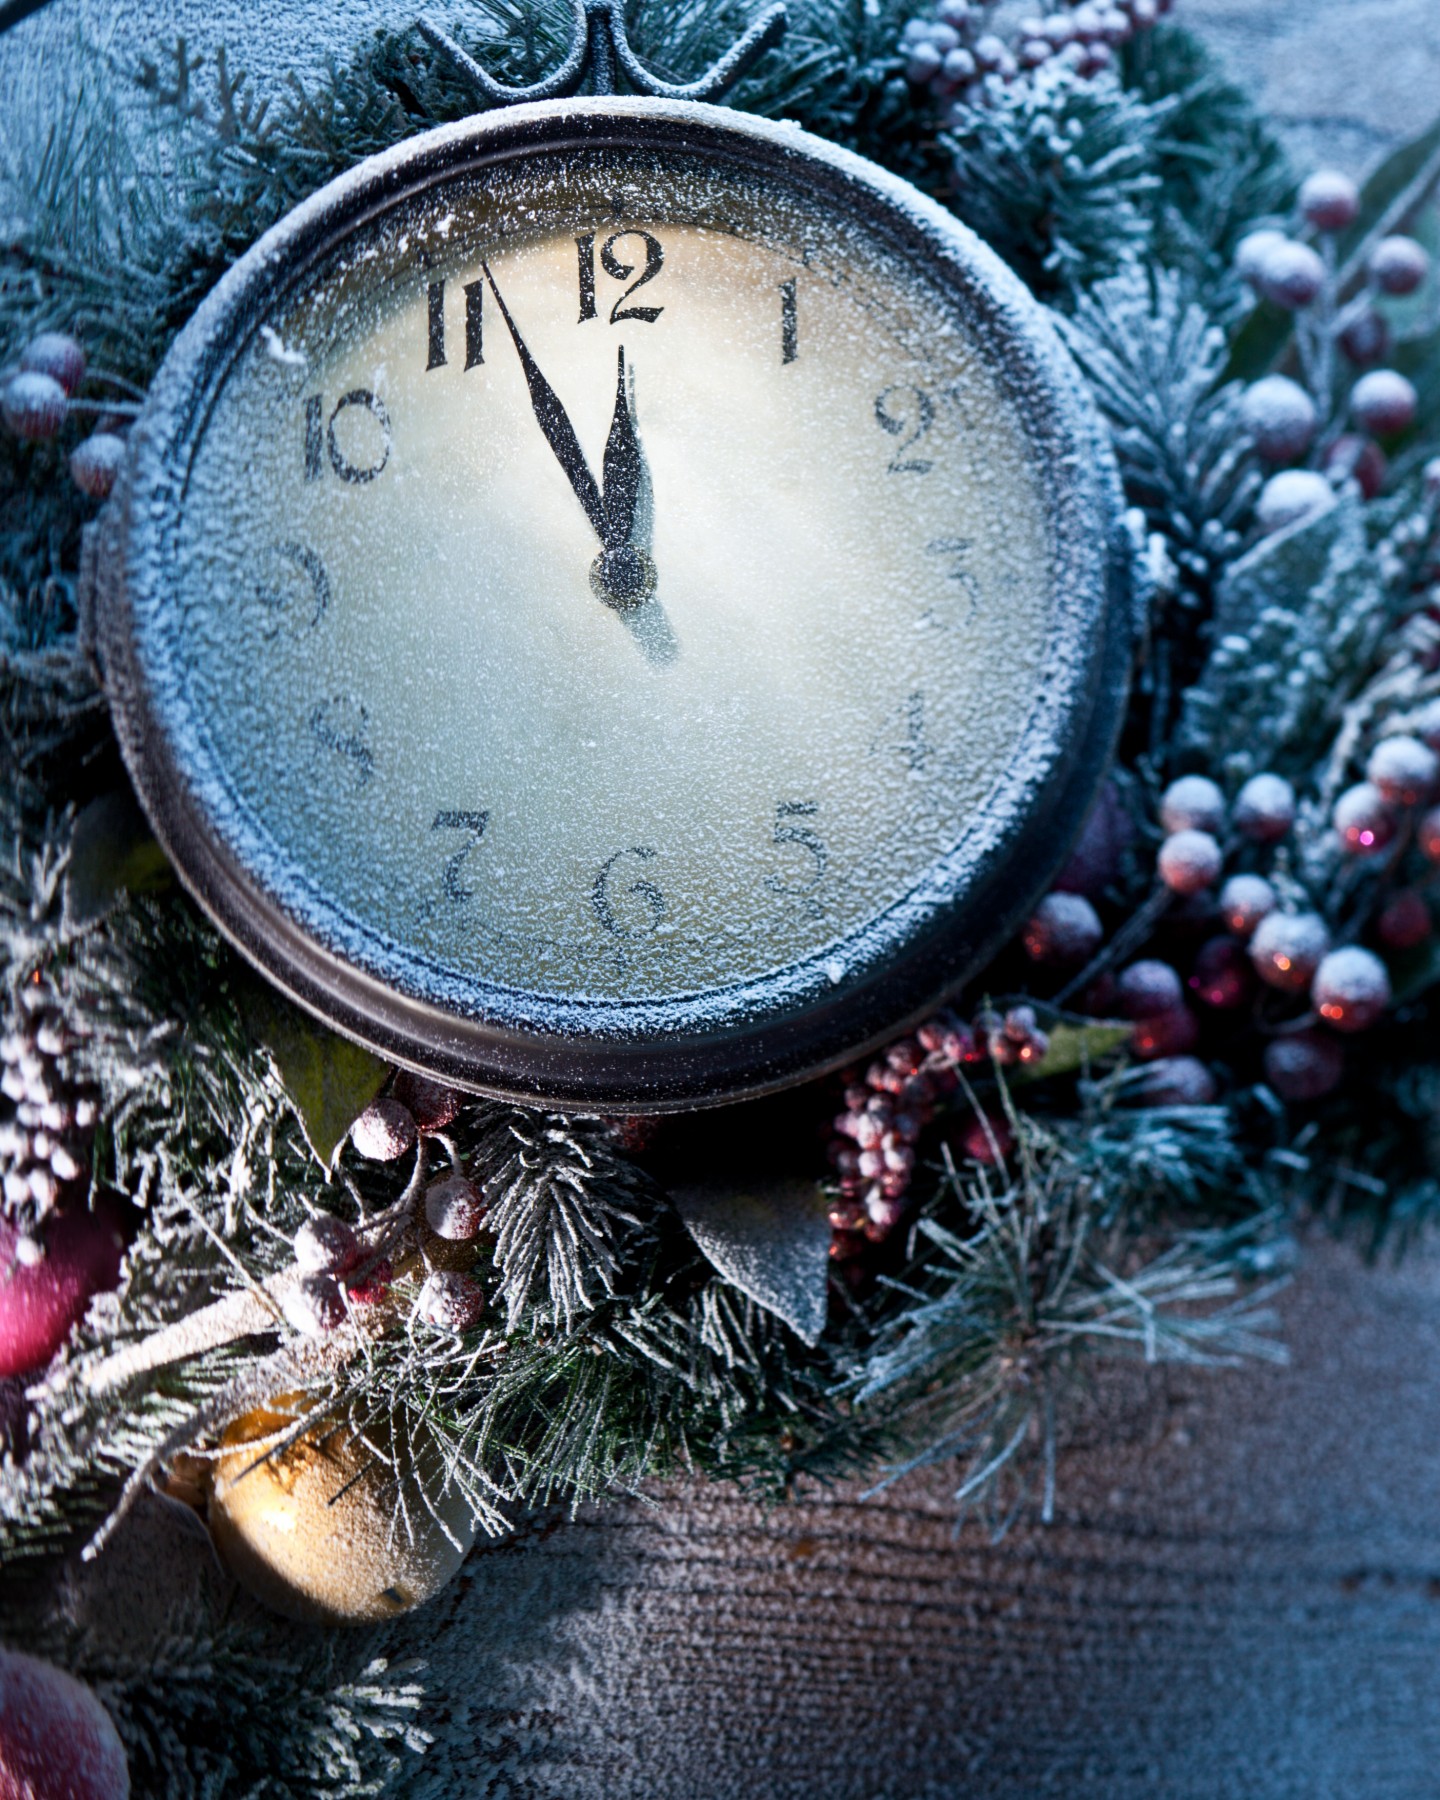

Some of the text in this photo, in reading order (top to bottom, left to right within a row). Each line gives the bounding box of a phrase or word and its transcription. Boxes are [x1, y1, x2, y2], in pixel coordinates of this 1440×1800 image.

[573, 229, 666, 326] 12
[779, 277, 799, 366] 1
[424, 279, 485, 373] 11
[303, 389, 391, 484] 10
[874, 385, 935, 475] 2
[431, 809, 490, 903] 7
[591, 846, 667, 939] 6
[764, 801, 828, 895] 5
